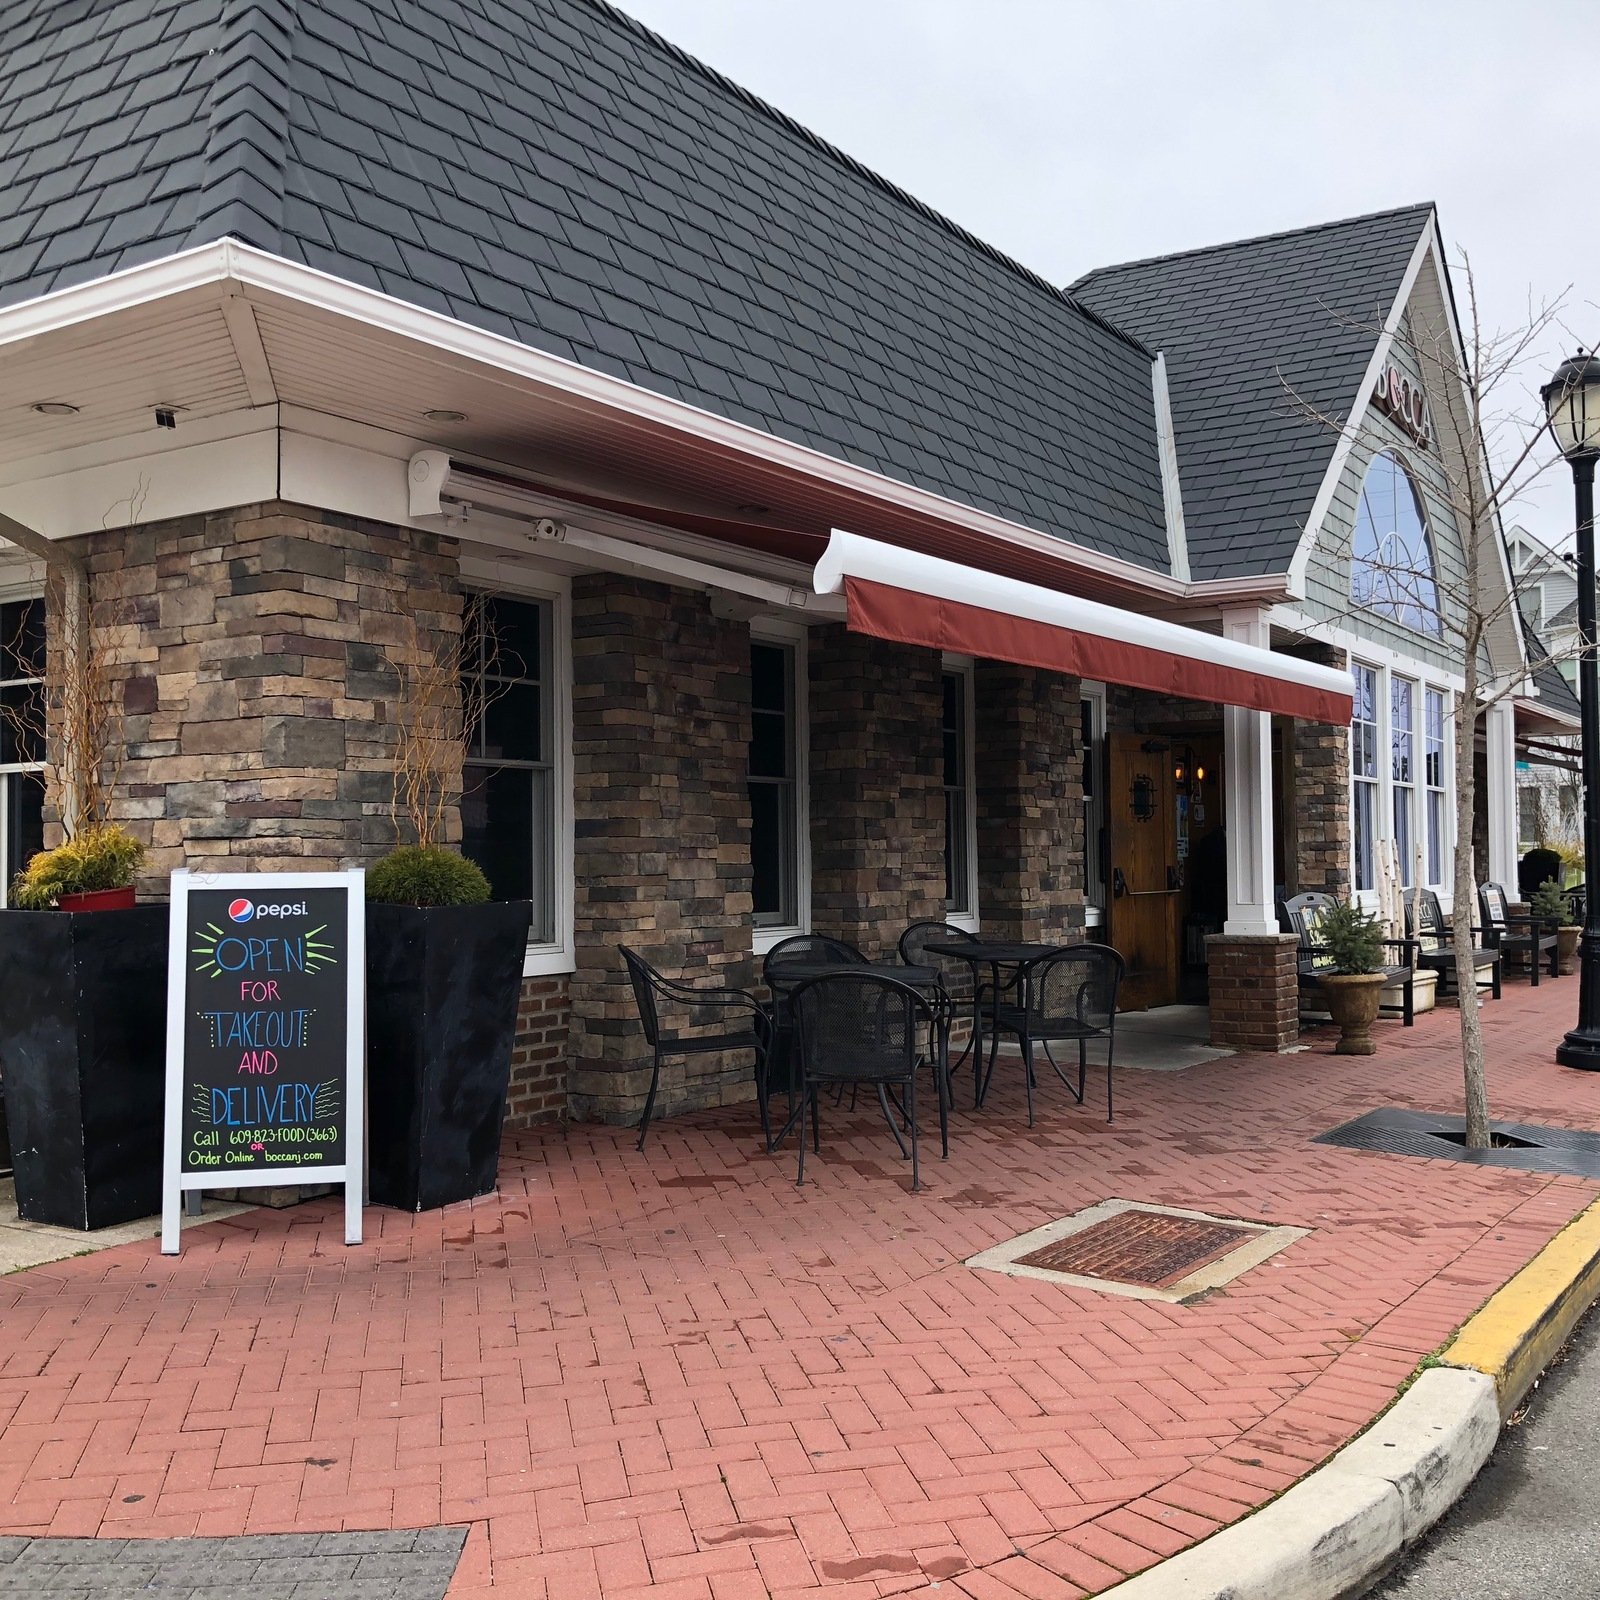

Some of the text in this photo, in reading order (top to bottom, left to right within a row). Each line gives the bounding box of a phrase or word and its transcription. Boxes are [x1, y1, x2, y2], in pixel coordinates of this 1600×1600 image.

[256, 901, 308, 919] pepsi
[216, 937, 305, 972] OPEN
[241, 980, 281, 1002] FOR
[204, 1009, 309, 1048] TAKEOUT
[238, 1050, 278, 1075] AND
[212, 1083, 320, 1125] DELIVERY
[193, 1130, 220, 1146] Call
[251, 1143, 264, 1151] OR
[188, 1150, 323, 1165] Order Online boccanj.com
